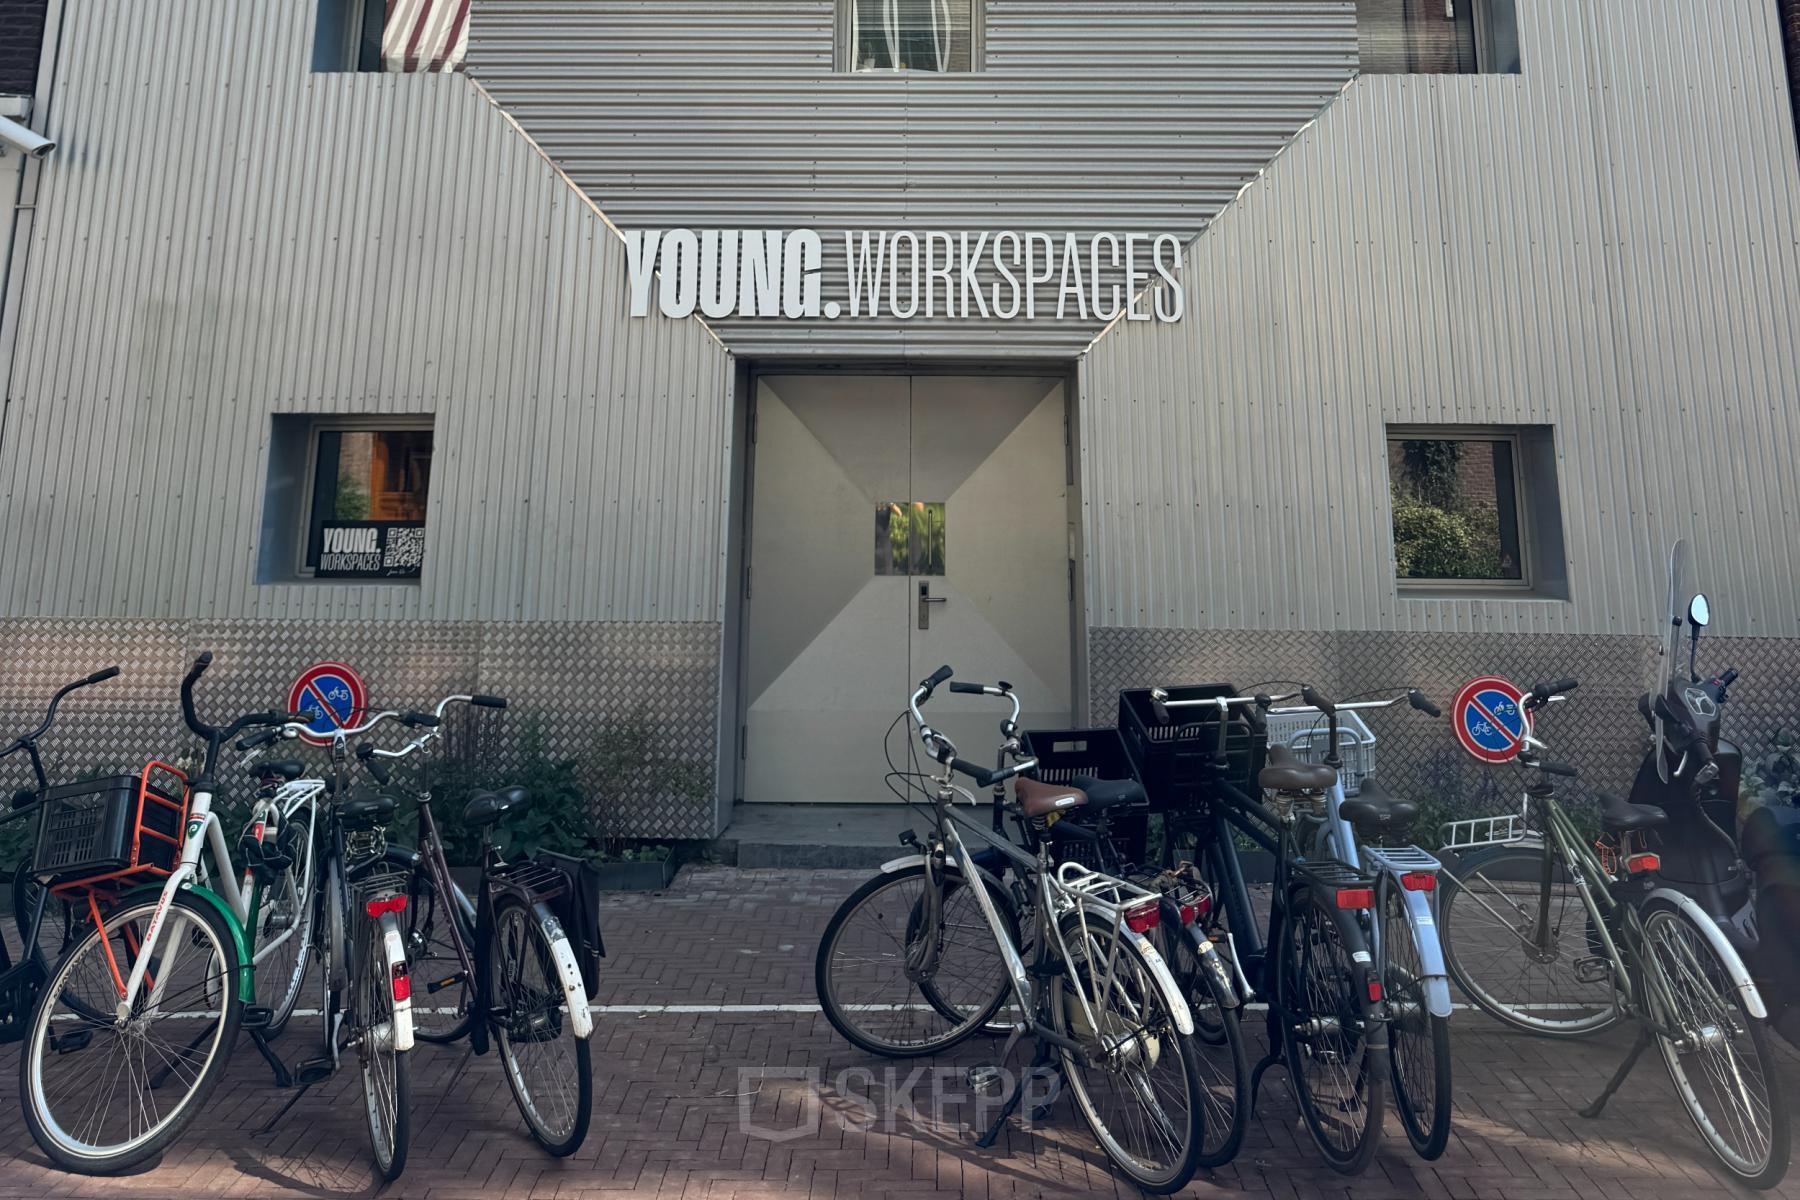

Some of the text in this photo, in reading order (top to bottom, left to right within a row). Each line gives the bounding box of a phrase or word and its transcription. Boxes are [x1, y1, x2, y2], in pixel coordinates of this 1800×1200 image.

[625, 229, 1183, 323] YOUNG. WORKSPACES
[323, 527, 381, 553] YOUNG.
[320, 553, 380, 571] WORKSPACES
[146, 891, 168, 942] BATAVUS
